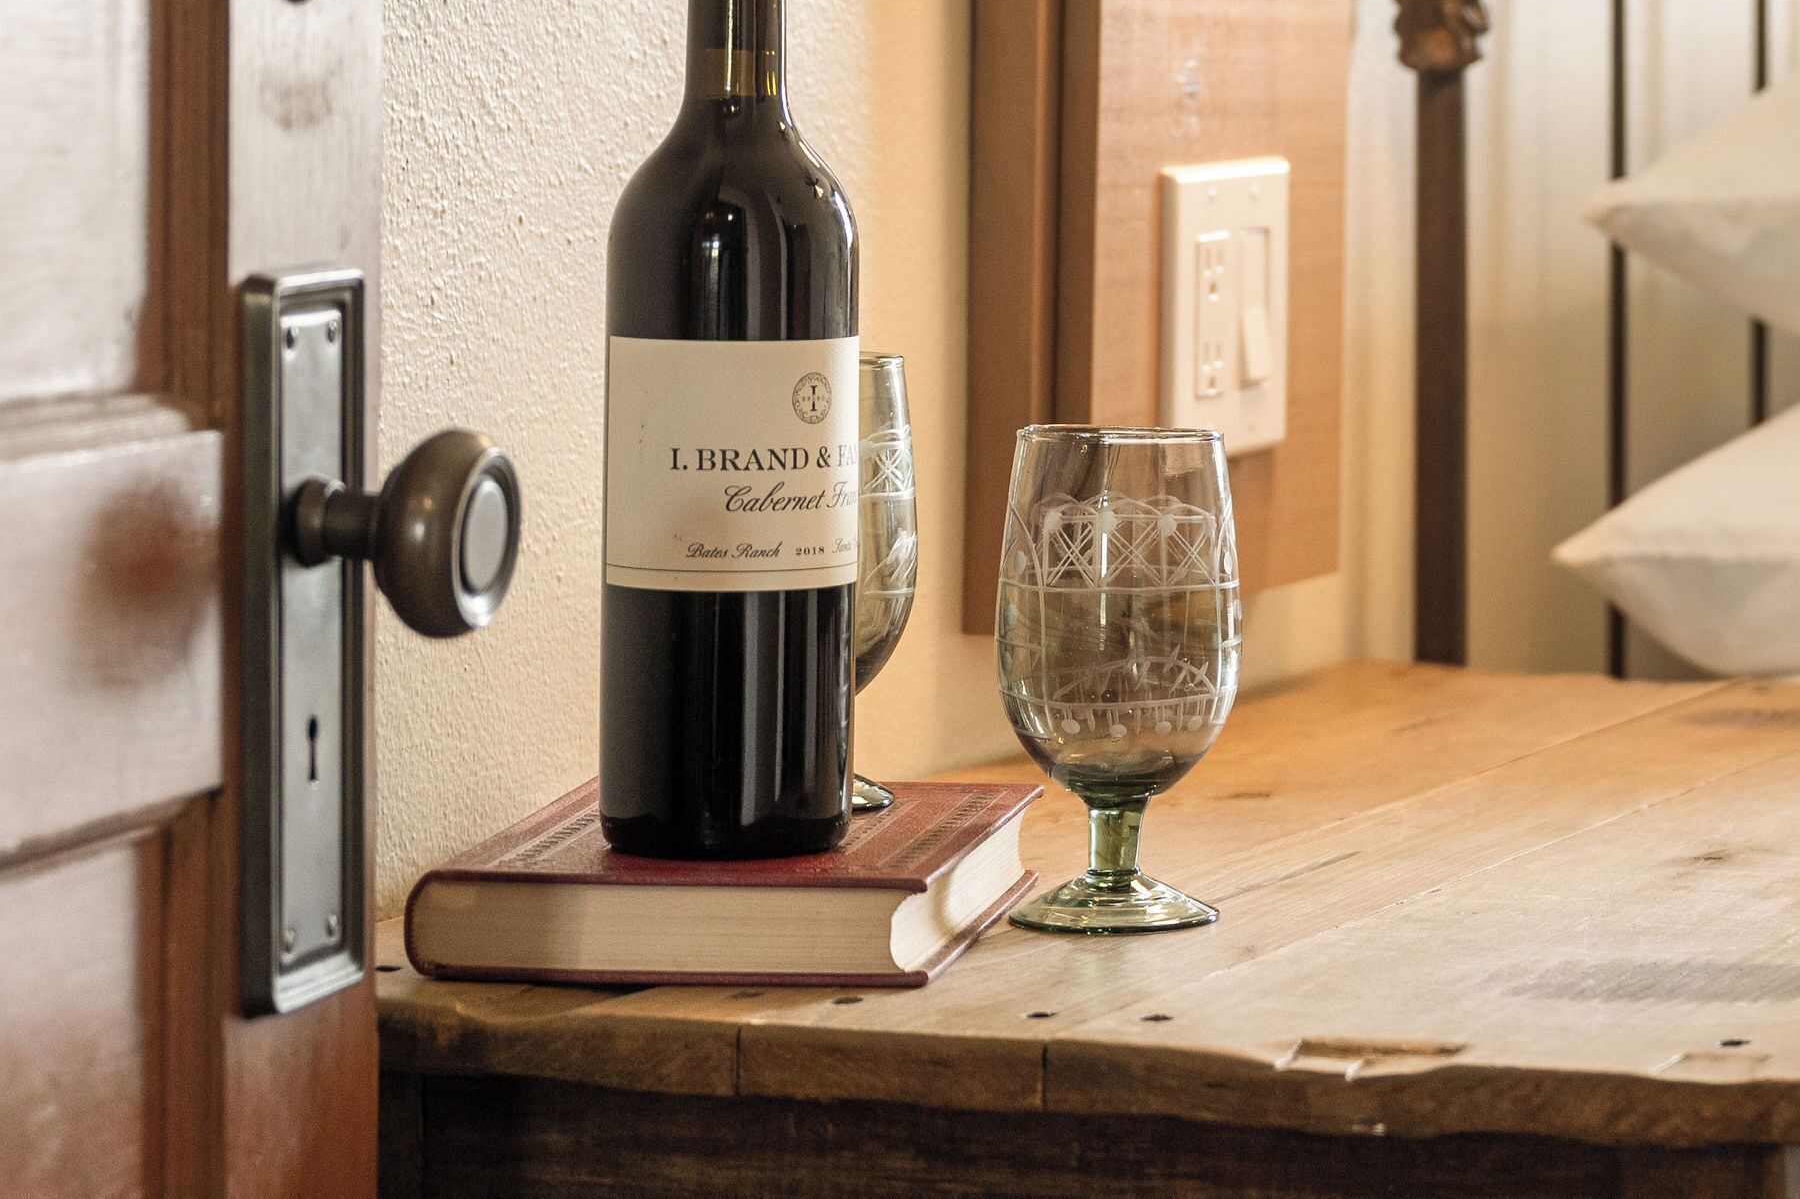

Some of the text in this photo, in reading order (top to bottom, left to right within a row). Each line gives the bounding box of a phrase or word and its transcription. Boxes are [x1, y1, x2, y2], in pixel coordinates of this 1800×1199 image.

[669, 447, 688, 471] I.
[695, 447, 809, 471] BRAND
[816, 445, 831, 469] &
[724, 481, 826, 512] Cabernet
[686, 542, 729, 559] Bates
[731, 540, 783, 559] Ranch
[795, 546, 825, 556] 2018
